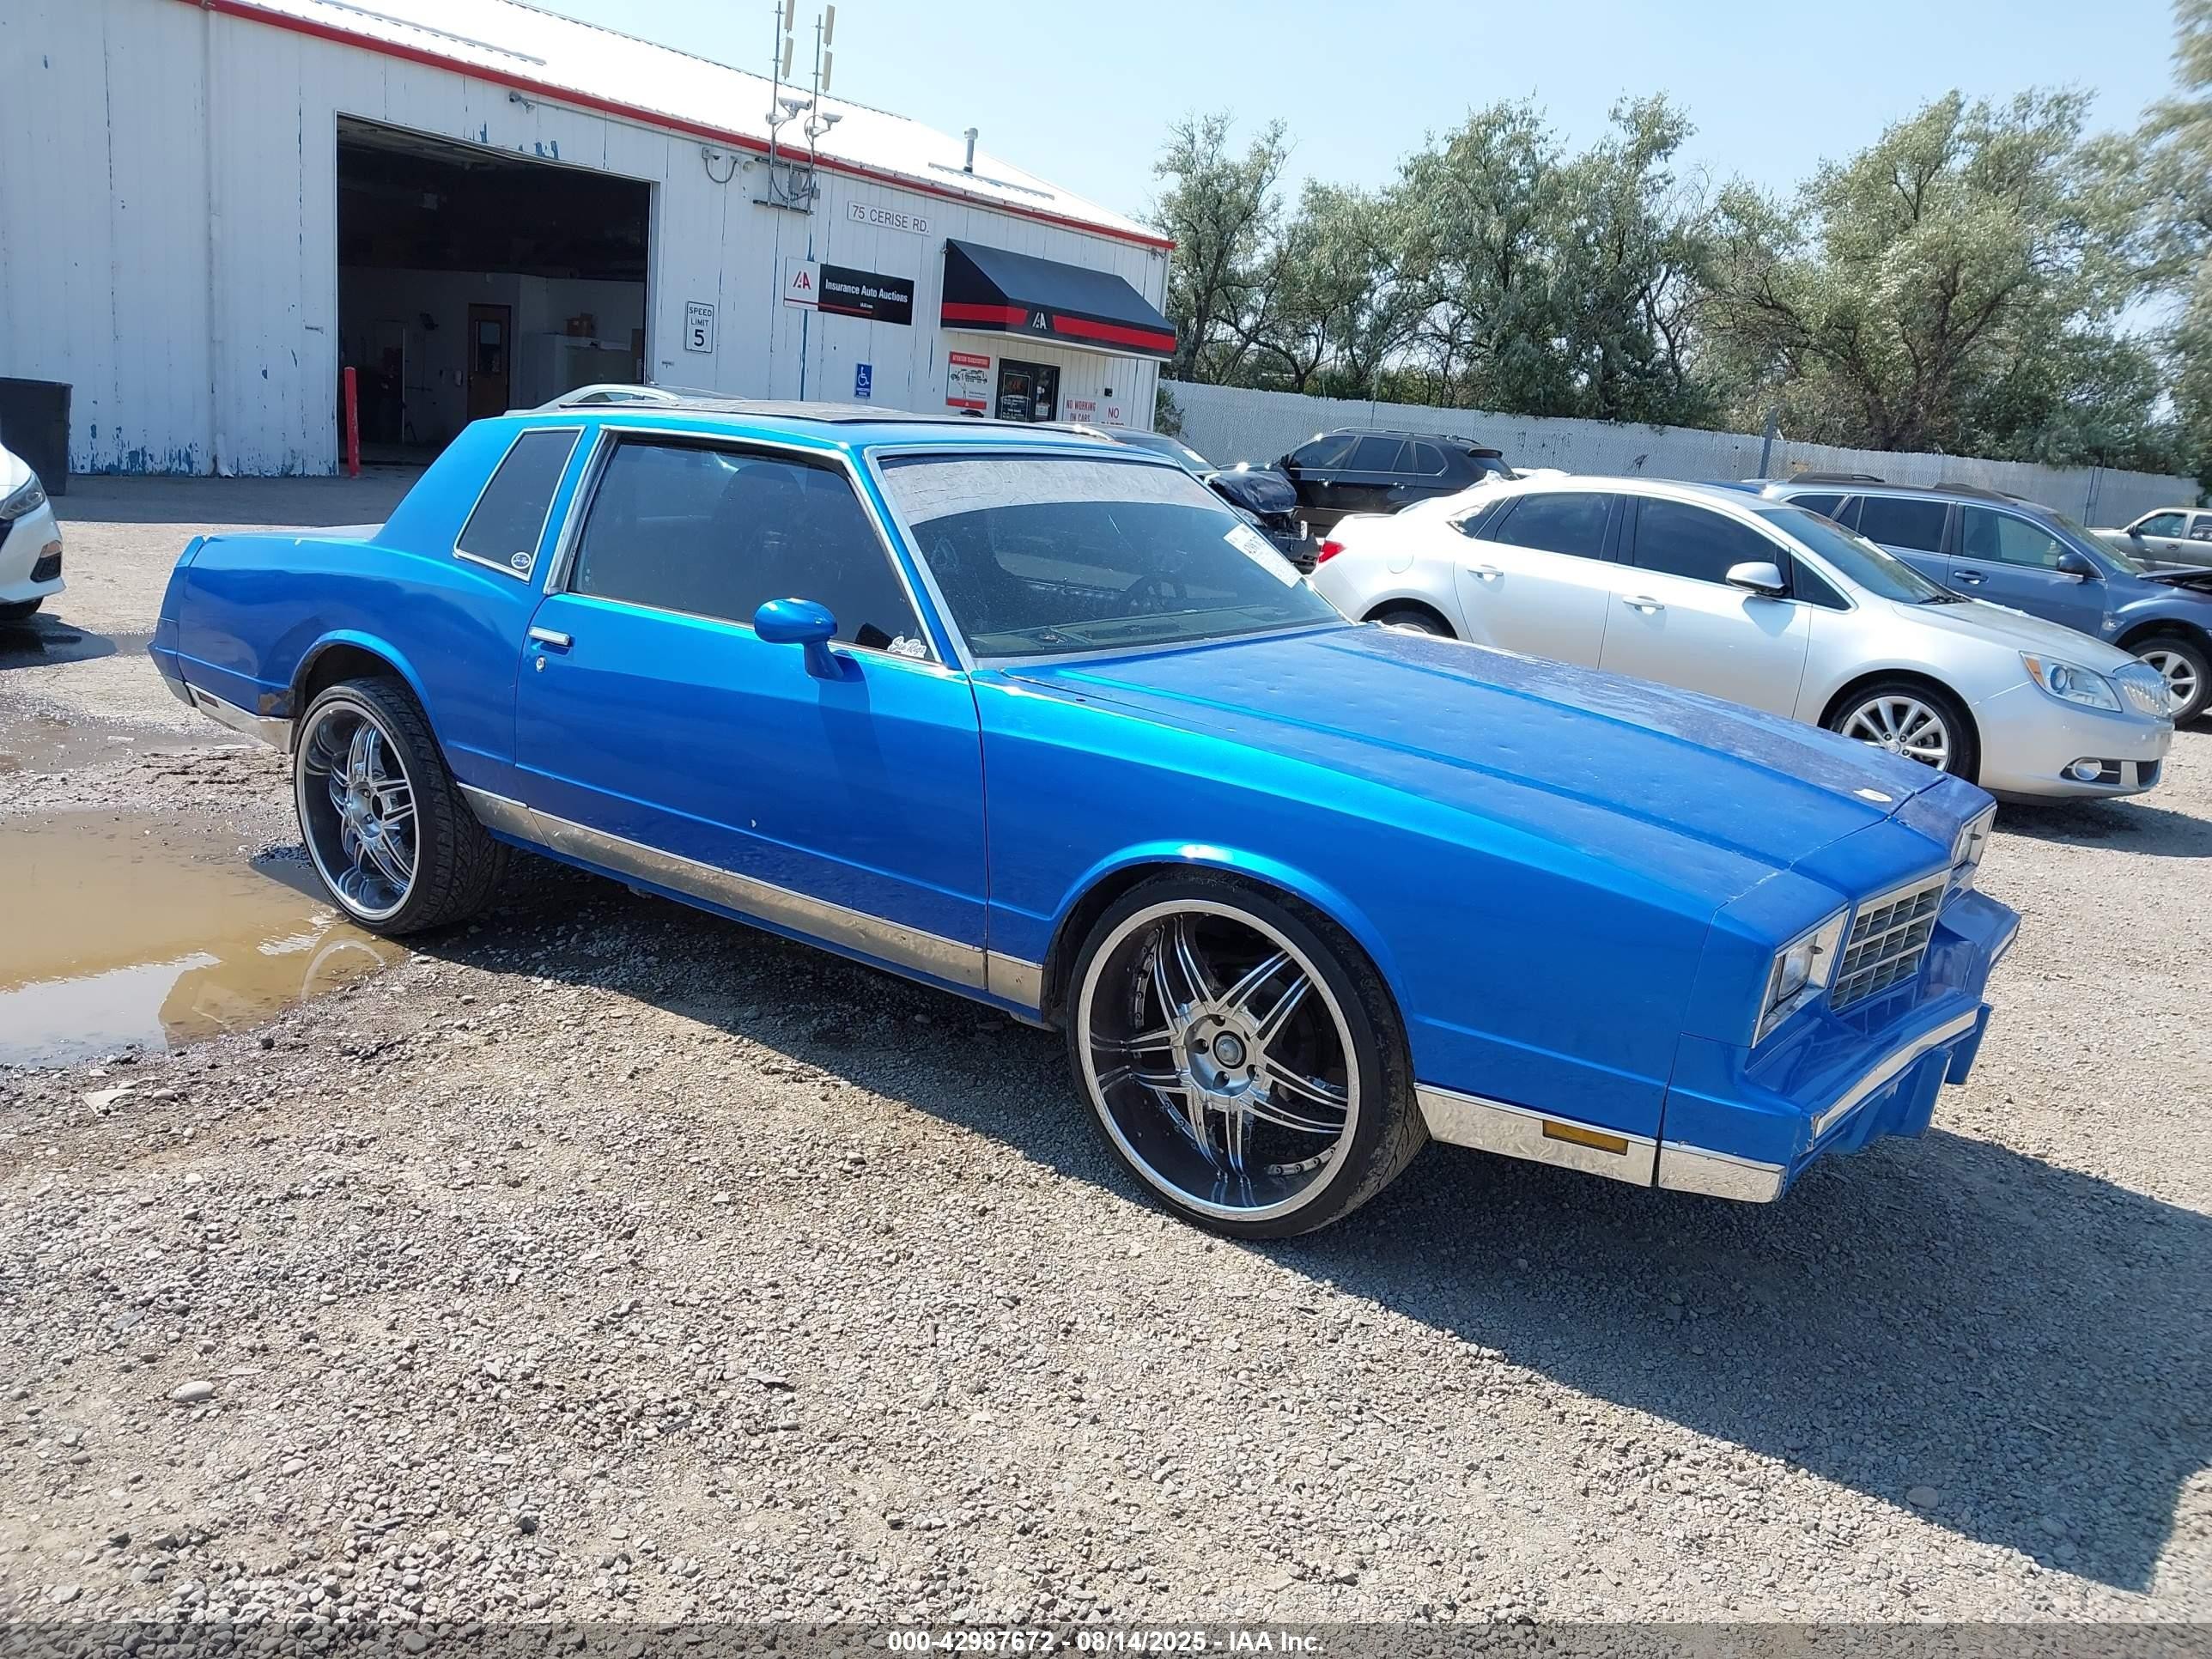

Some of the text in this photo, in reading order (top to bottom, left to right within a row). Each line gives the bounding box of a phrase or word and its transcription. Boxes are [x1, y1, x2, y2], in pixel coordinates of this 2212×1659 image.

[853, 205, 930, 234] 75 CERISE RD.
[825, 278, 908, 303] Insurance Auto Auctions
[689, 307, 713, 317] SPEED
[690, 317, 709, 327] LIMIT
[694, 329, 705, 347] 5
[1066, 399, 1073, 409] NO
[1078, 413, 1091, 422] CARS
[1108, 407, 1120, 419] NO
